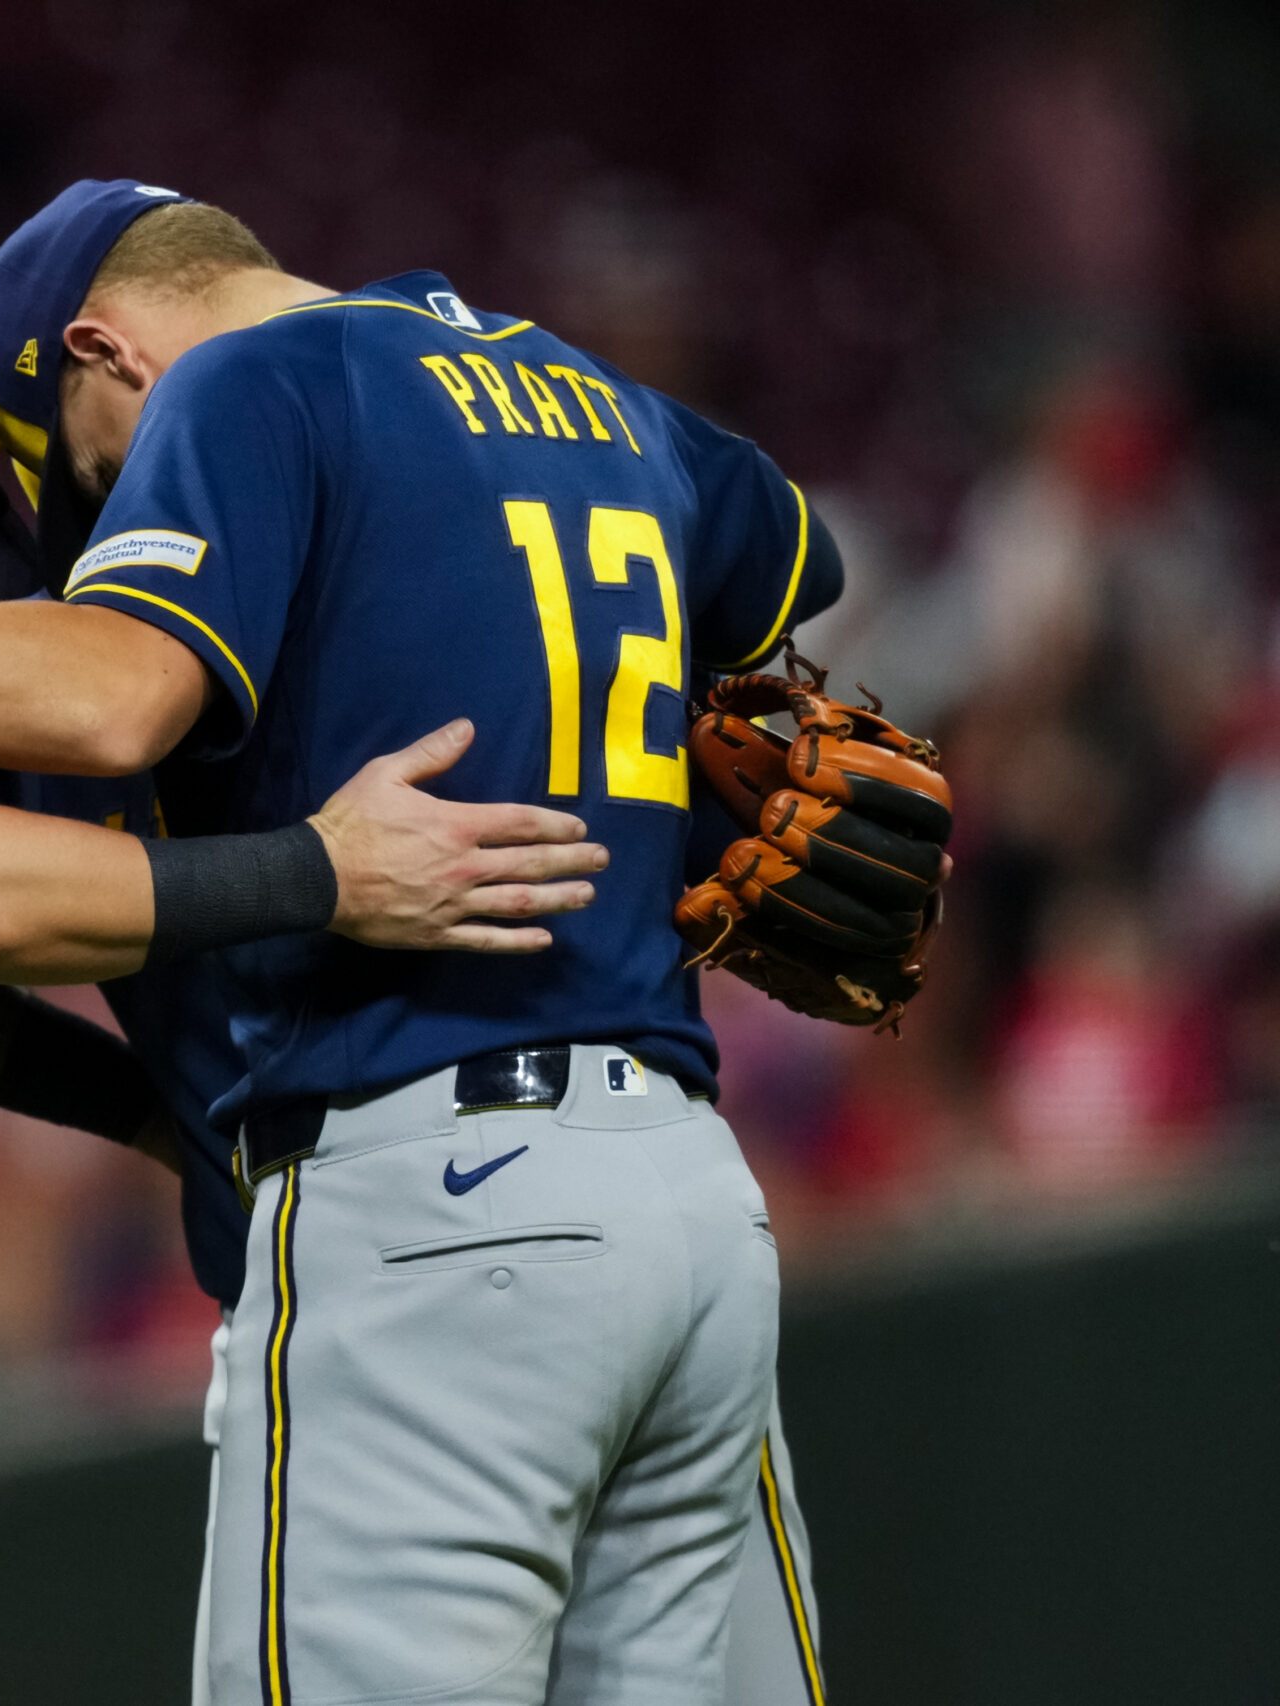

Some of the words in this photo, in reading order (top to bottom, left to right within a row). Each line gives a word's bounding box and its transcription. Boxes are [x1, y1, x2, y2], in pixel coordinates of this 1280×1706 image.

[419, 352, 642, 458] PRATT
[95, 547, 143, 565] Mutual
[97, 539, 196, 556] Northwestern
[502, 499, 691, 811] 12
